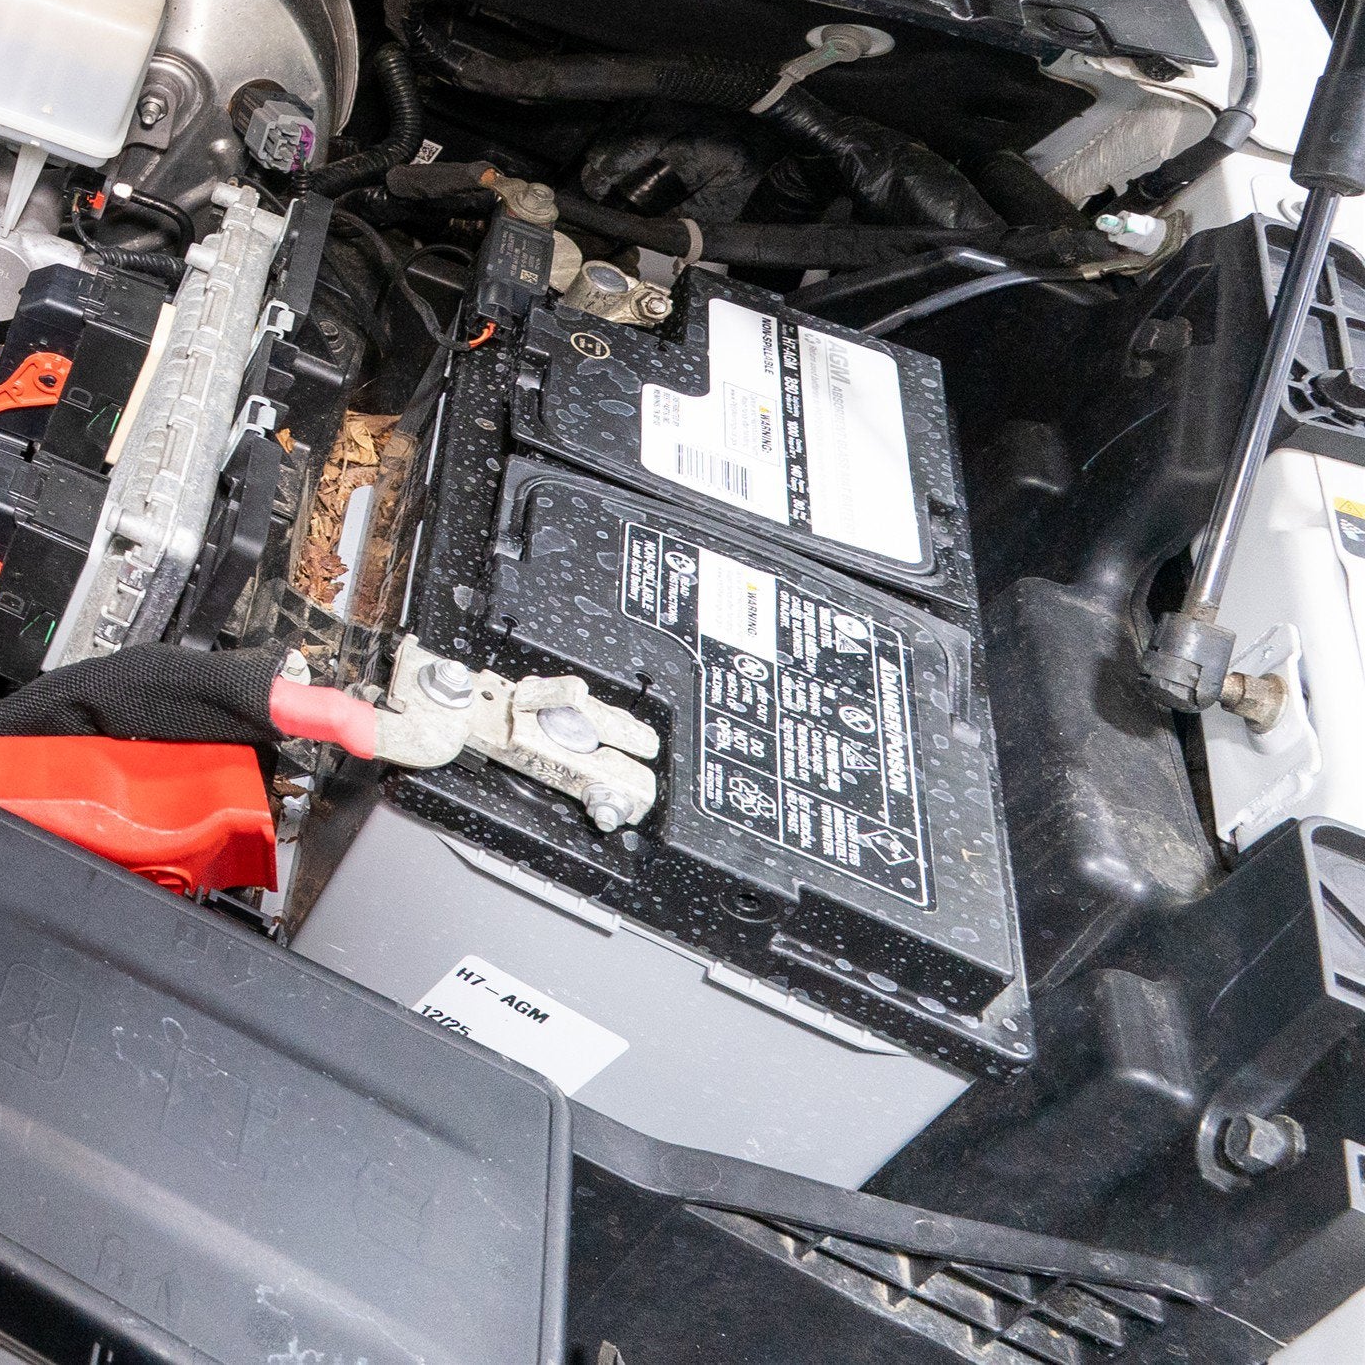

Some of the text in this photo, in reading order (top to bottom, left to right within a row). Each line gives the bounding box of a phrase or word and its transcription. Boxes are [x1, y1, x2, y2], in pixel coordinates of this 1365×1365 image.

[761, 316, 773, 375] NON-SPILLABLE
[780, 334, 797, 371] H7-AGM
[827, 338, 849, 385] AGM
[782, 374, 798, 396] 850
[759, 412, 772, 455] WARNING:
[630, 555, 642, 576] Acid
[640, 538, 656, 612] NON-SPILLABLE
[626, 572, 641, 602] Battery
[679, 574, 689, 597] READ
[746, 589, 758, 640] WARNING:
[755, 702, 767, 724] OUT
[732, 726, 747, 756] NOT
[749, 736, 764, 759] DO
[879, 668, 908, 797] DANGER/POISON
